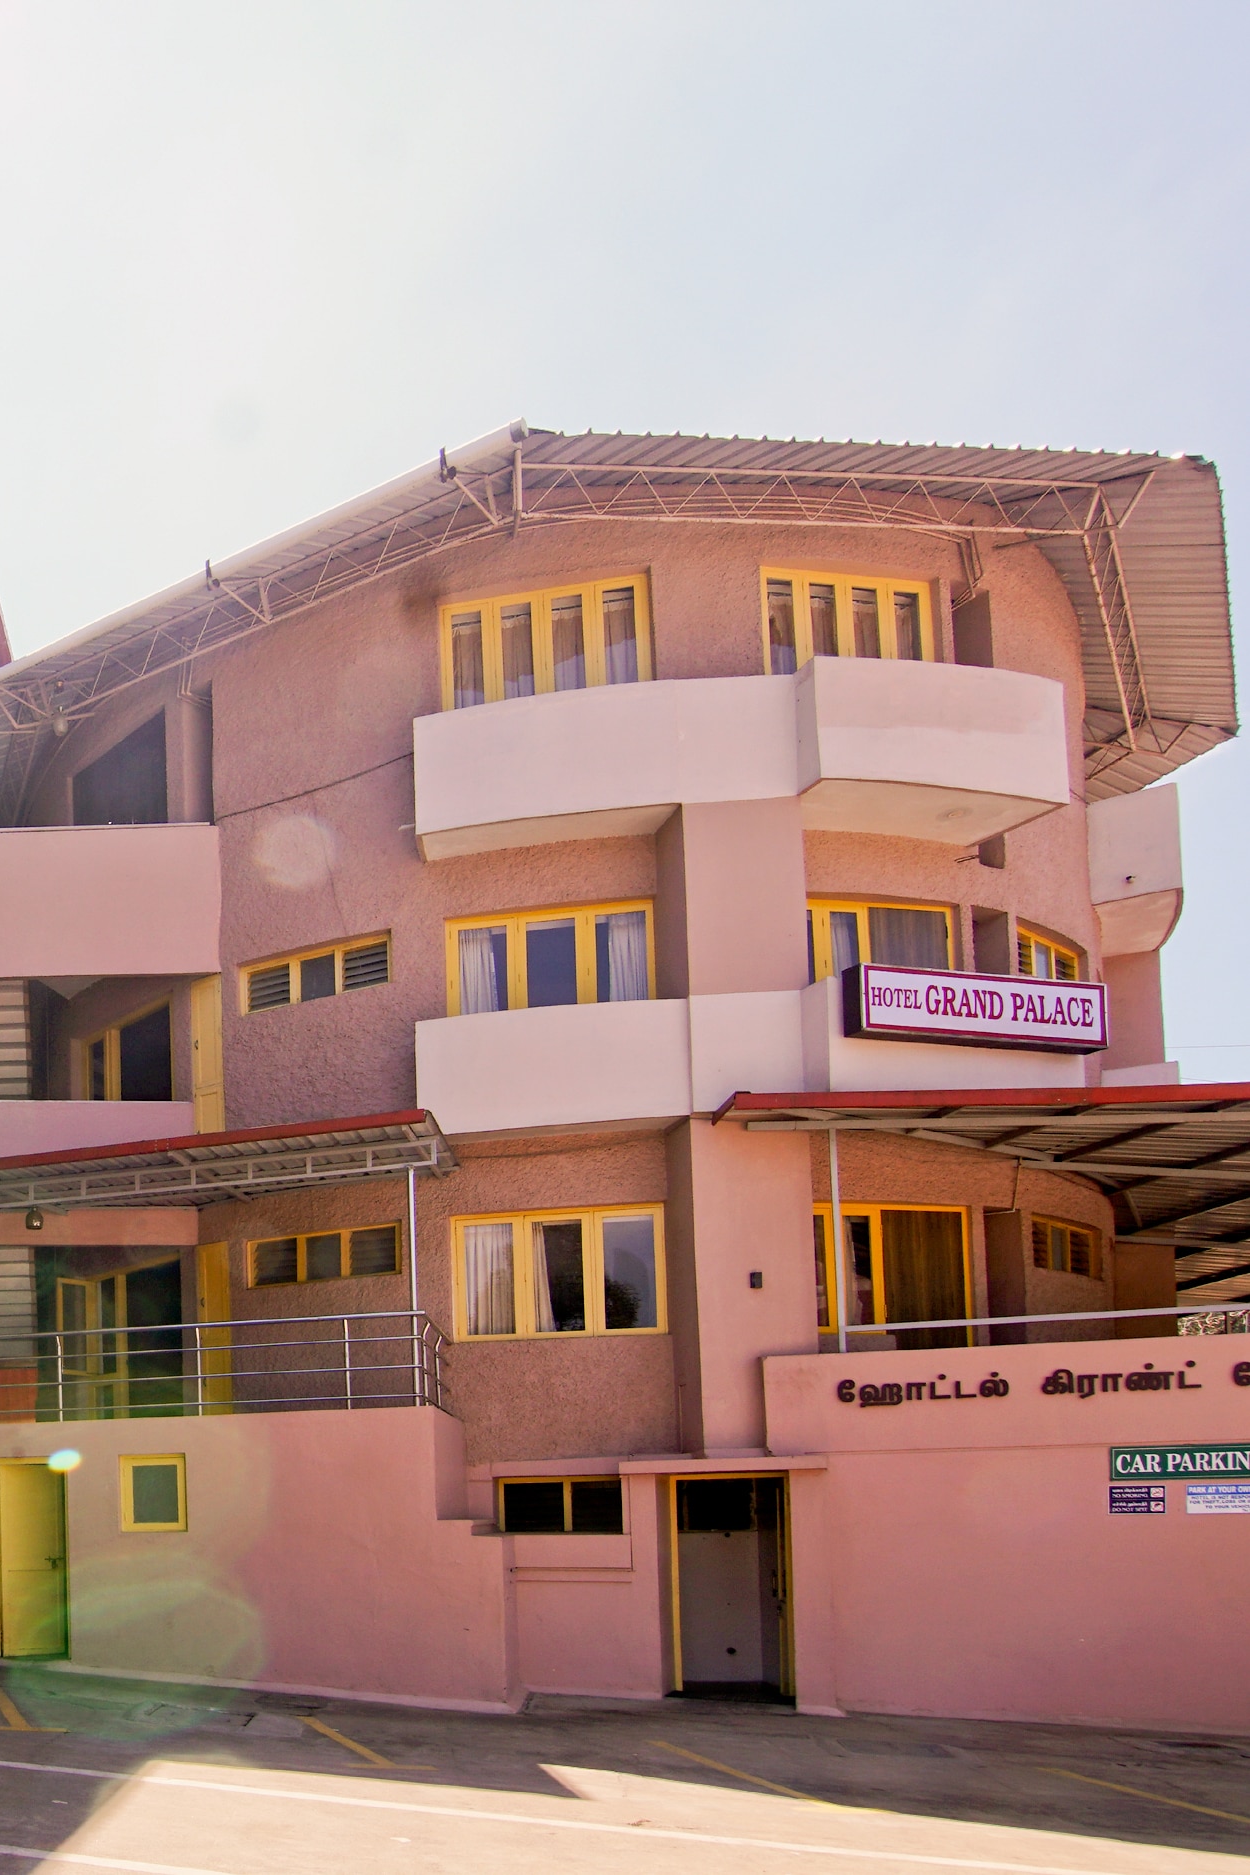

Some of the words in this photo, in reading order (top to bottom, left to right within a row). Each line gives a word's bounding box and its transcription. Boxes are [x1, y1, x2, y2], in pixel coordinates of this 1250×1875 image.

[871, 986, 922, 1010] HOTEL
[925, 984, 1004, 1020] GRAND
[1010, 992, 1095, 1028] PALACE
[837, 1371, 1010, 1408] ஹோட்டல்
[1041, 1360, 1202, 1399] கிராண்ட்
[1116, 1453, 1162, 1474] CAR
[1188, 1486, 1207, 1494] PARK
[1218, 1485, 1237, 1493] YOUR
